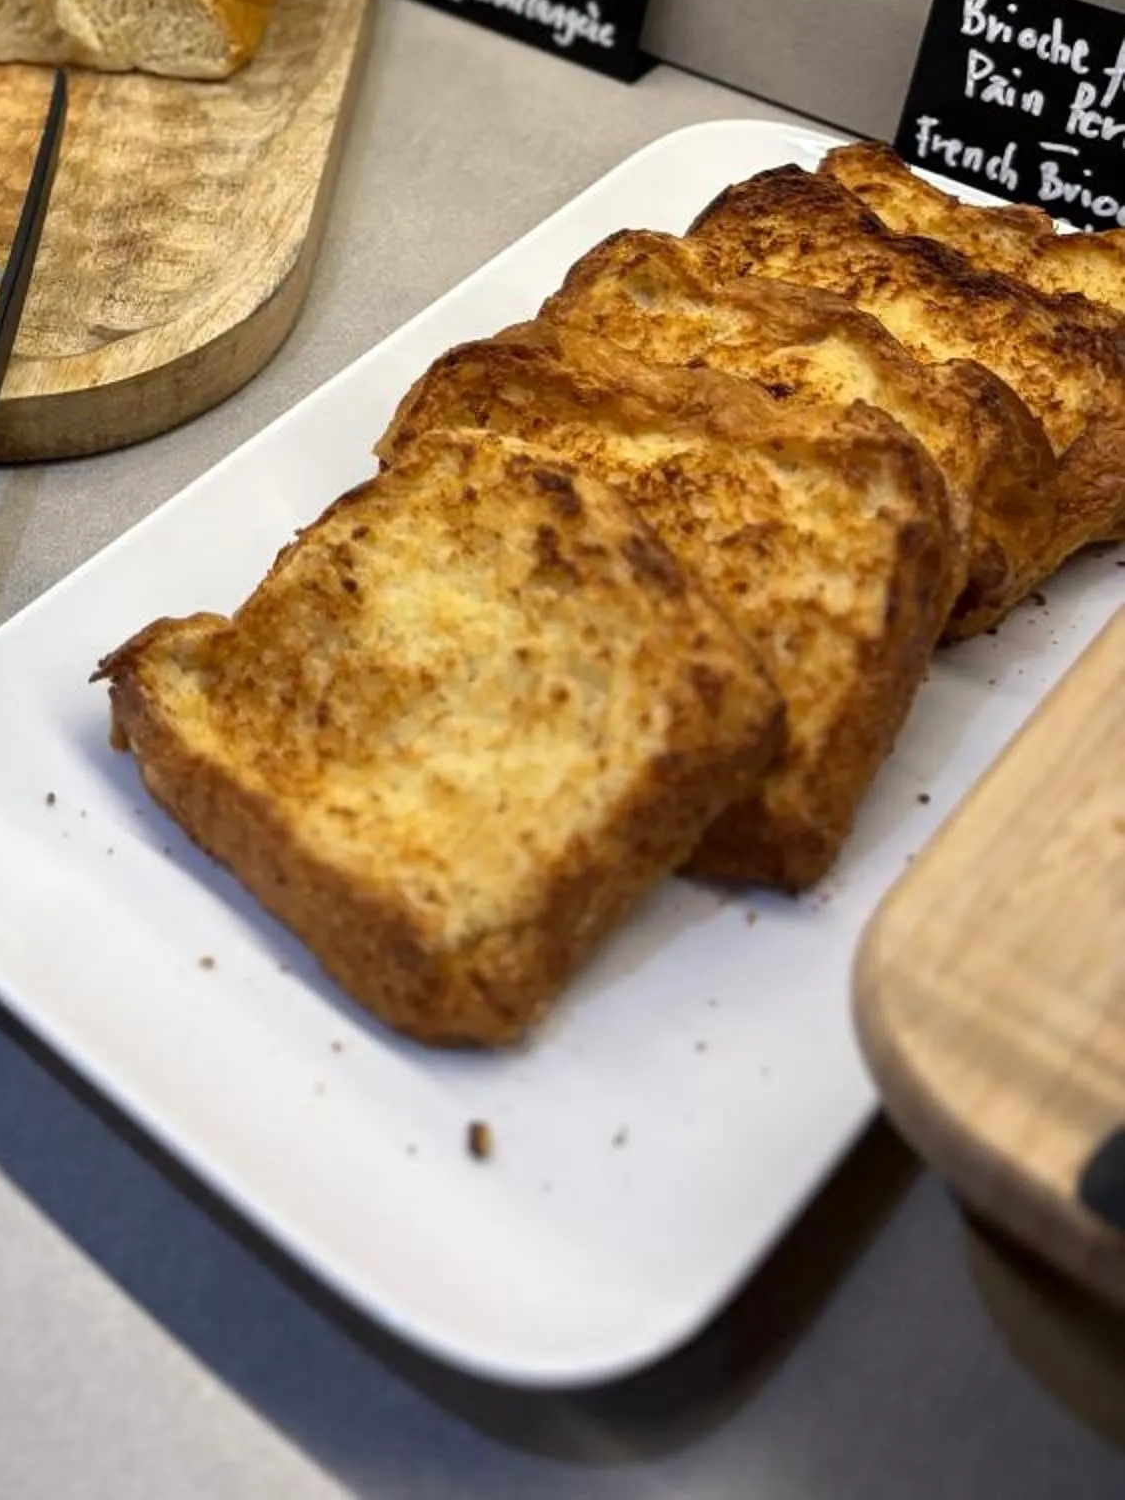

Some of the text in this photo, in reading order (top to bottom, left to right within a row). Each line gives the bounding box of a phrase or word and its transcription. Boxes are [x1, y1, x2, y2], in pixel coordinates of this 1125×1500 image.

[965, 48, 1044, 117] Pain
[1065, 81, 1125, 141] Per
[916, 115, 1018, 191] French
